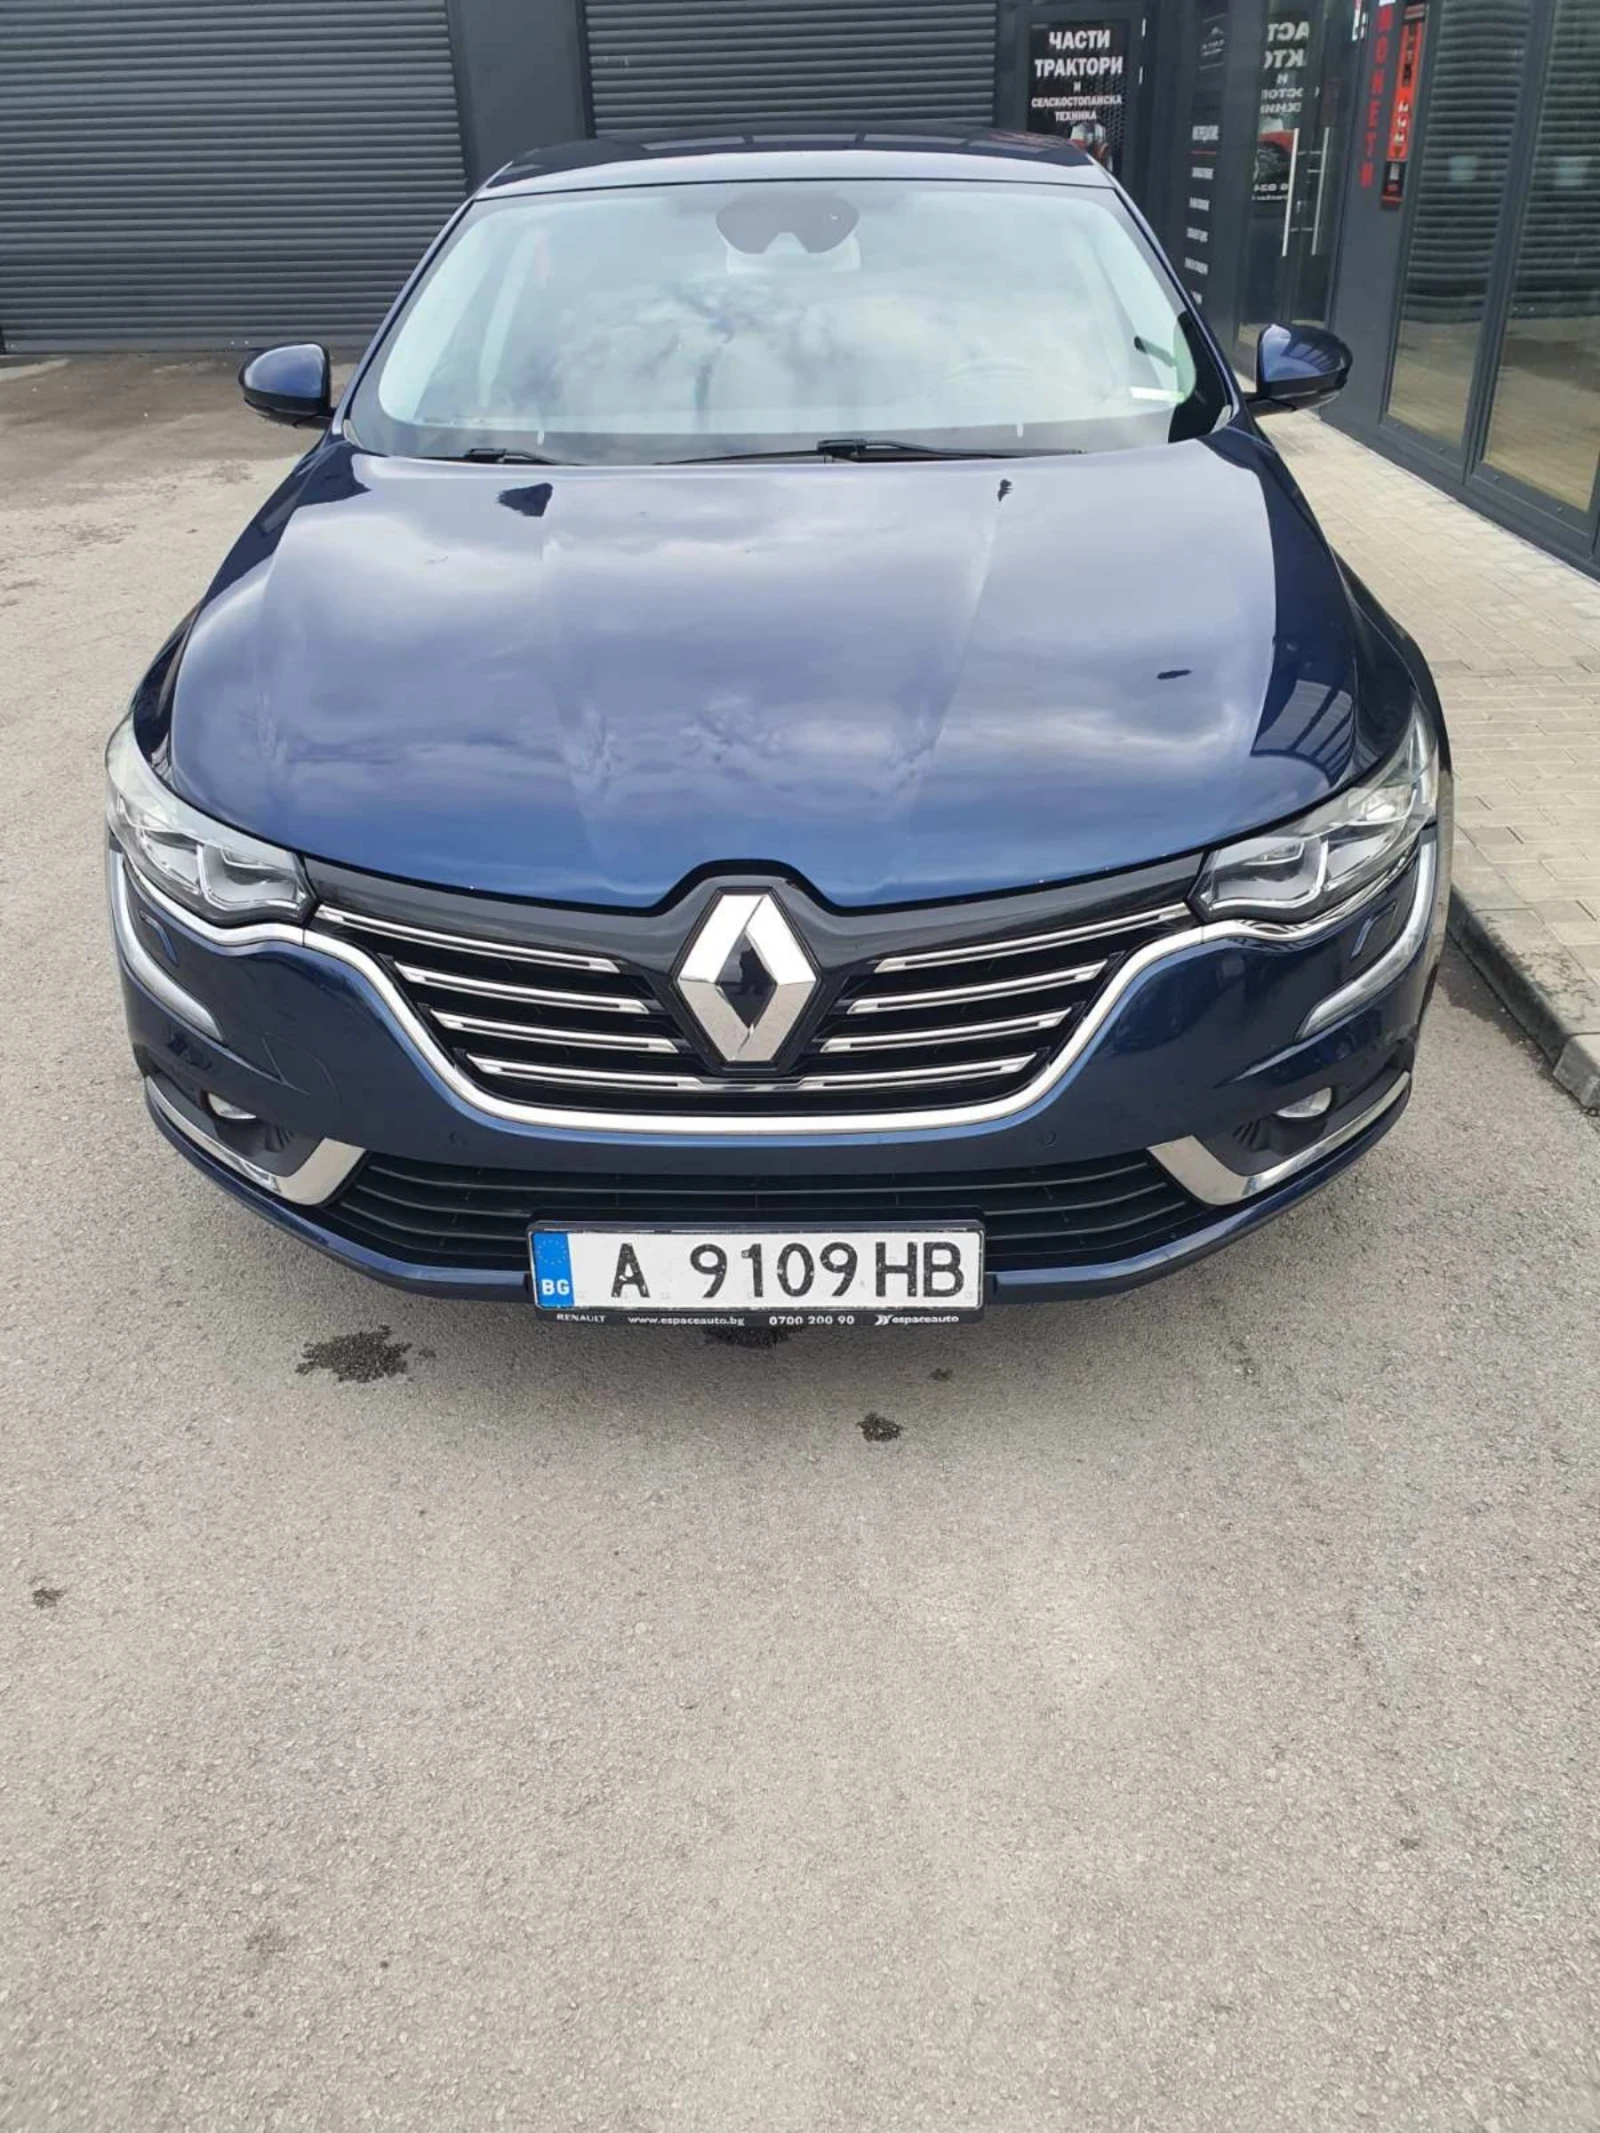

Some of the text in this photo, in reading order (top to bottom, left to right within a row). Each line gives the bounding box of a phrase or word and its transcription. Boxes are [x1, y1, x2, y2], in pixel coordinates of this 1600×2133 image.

[1049, 29, 1111, 50] ЧАСТИ
[1034, 56, 1124, 77] ТРАКТОРИ
[610, 1241, 965, 1299] A 9109 HB
[541, 1279, 571, 1296] BG
[556, 1313, 607, 1324] RENAULT
[627, 1315, 746, 1327] www.espaceauto.bg
[768, 1314, 856, 1326] 0700 200 90
[891, 1314, 961, 1326] espaceauto
